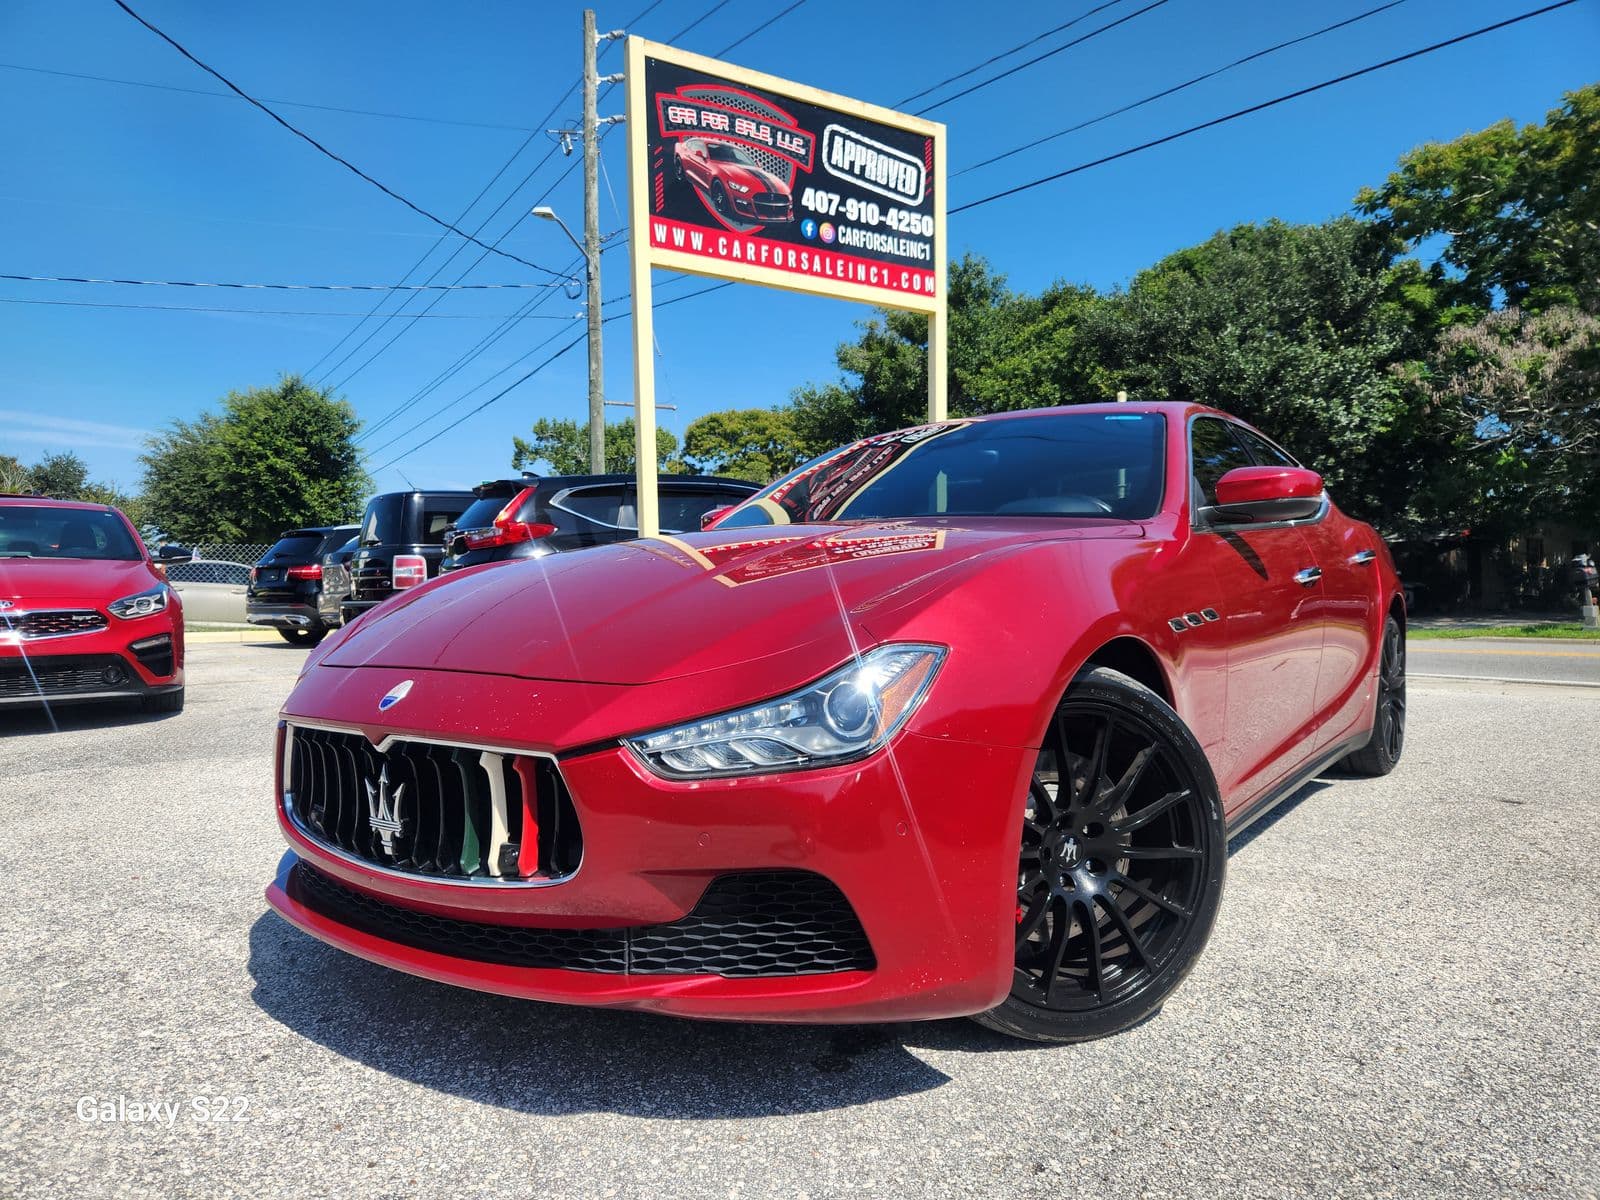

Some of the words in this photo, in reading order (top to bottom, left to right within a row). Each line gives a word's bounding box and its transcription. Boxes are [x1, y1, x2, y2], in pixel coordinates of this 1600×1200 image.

[667, 106, 698, 126] CAR
[701, 111, 730, 132] FOR
[831, 135, 918, 196] APPROVED
[801, 187, 934, 237] 407-910-4250
[838, 225, 931, 261] CARFORSALEINC1
